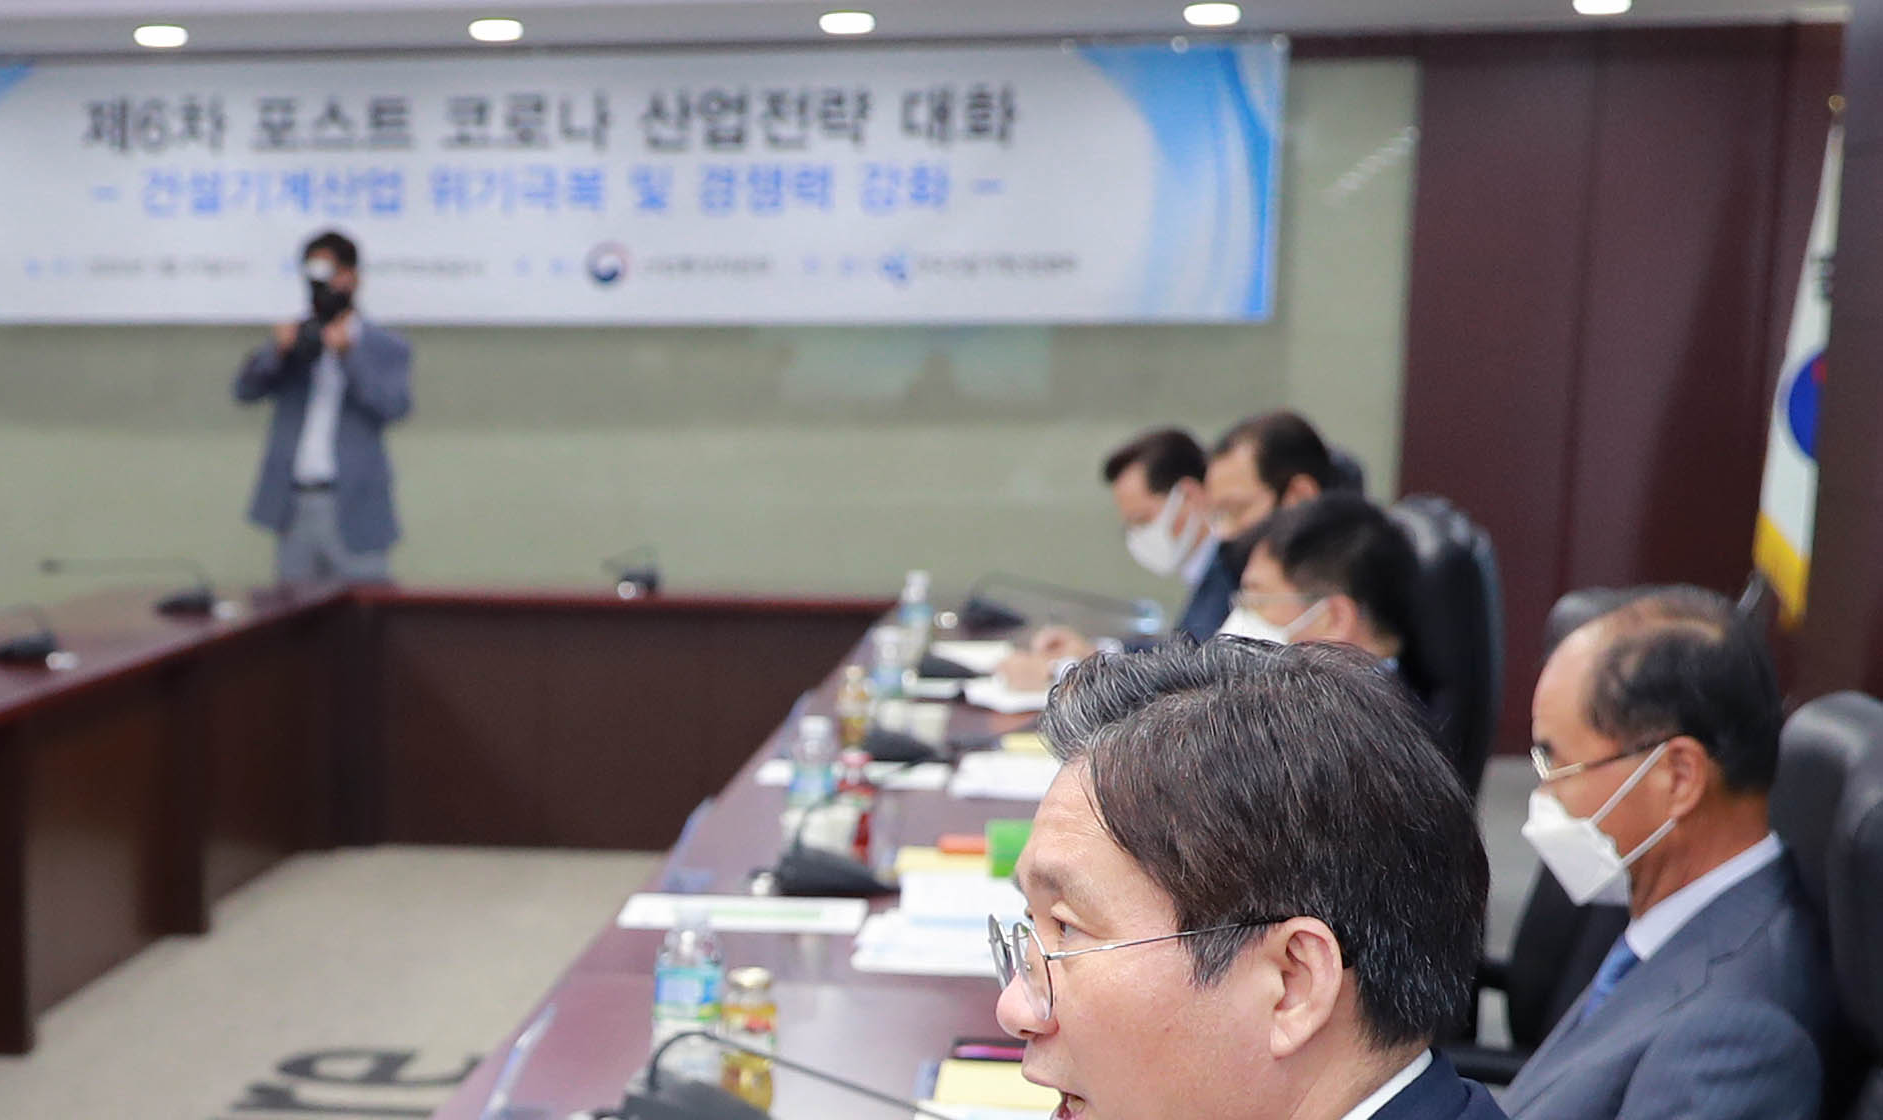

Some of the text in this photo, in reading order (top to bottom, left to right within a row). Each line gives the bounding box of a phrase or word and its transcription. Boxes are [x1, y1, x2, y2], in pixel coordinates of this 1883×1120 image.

[84, 82, 1018, 156] 제6차 포스트 코로나 산업전략 대화
